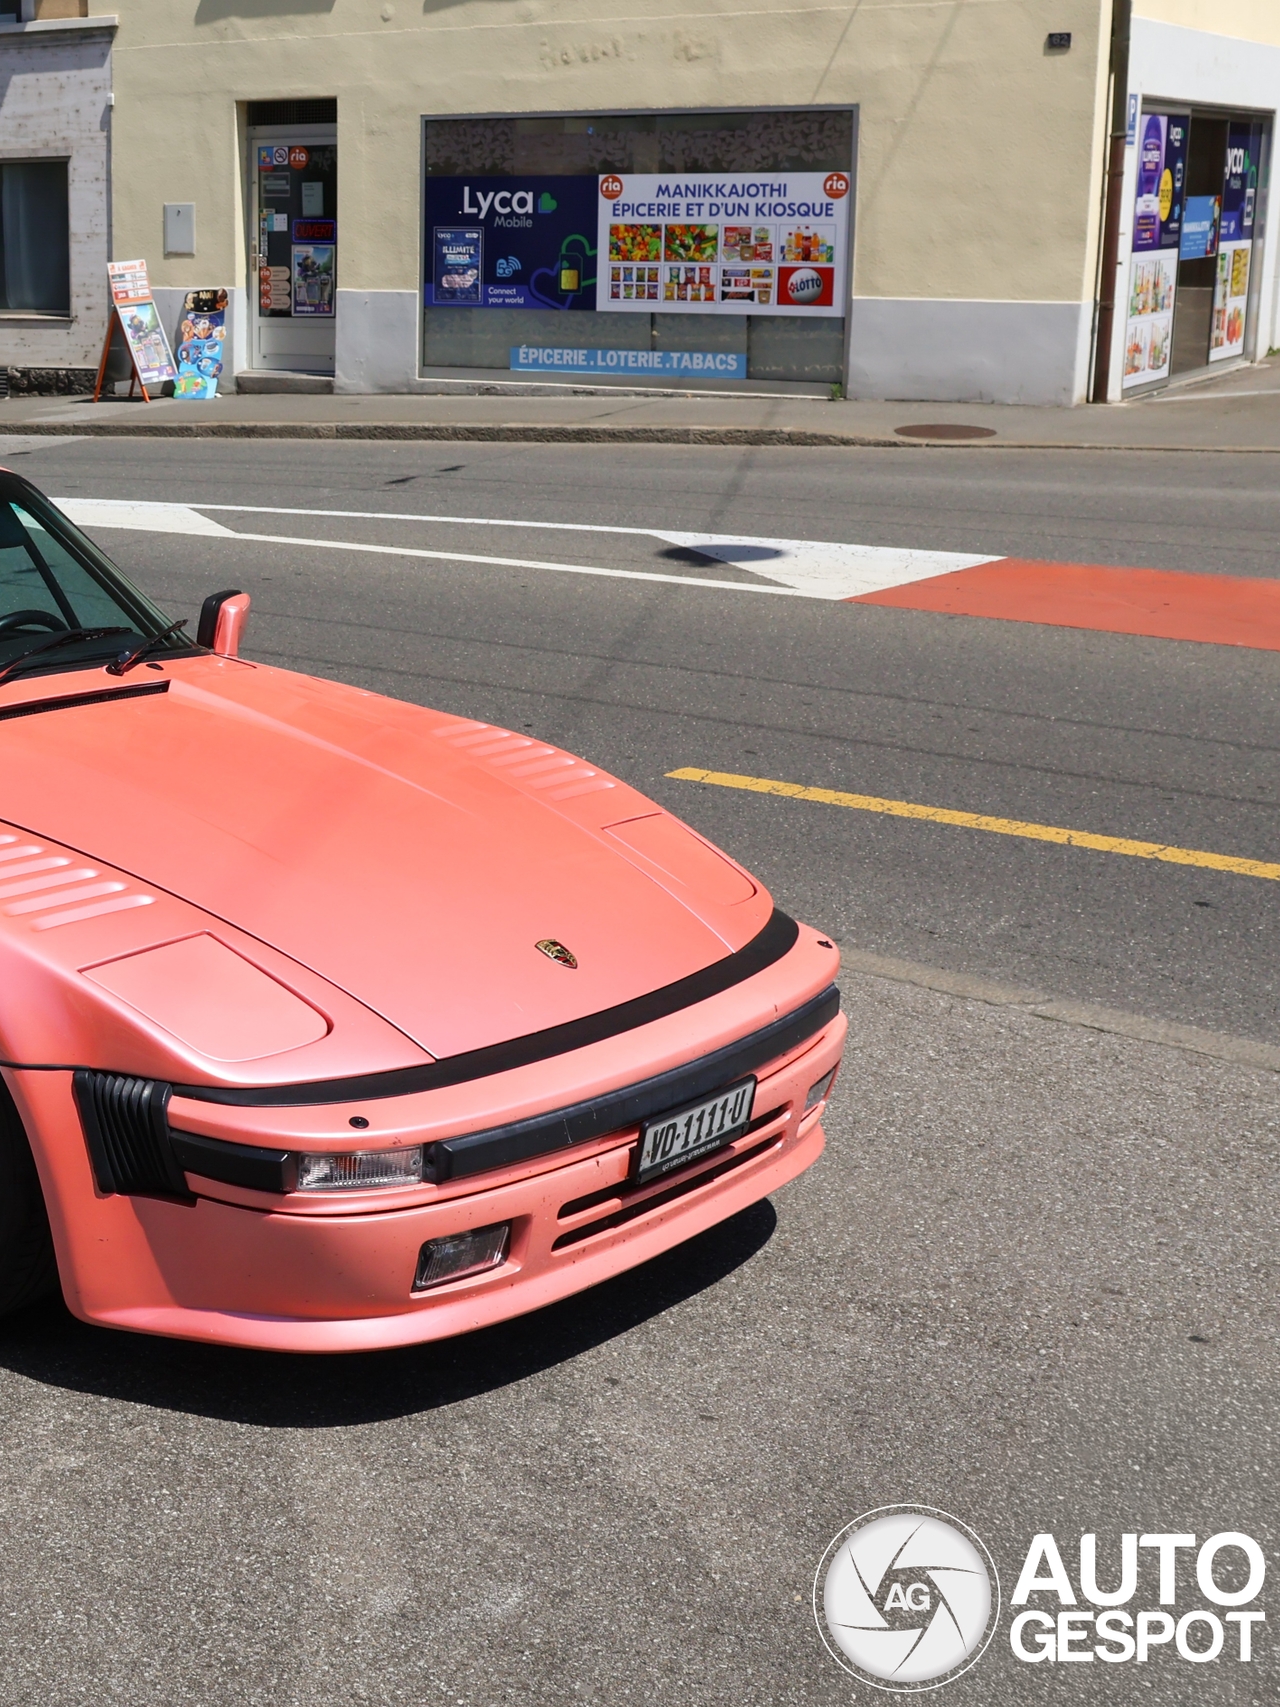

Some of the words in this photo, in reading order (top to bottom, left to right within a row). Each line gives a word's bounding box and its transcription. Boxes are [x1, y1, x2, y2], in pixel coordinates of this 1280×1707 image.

[291, 149, 306, 161] ria
[1224, 148, 1244, 180] yca
[602, 180, 620, 191] ria
[825, 178, 846, 190] ria
[655, 183, 787, 198] MANIKKAJOTHI
[463, 186, 533, 219] Lyca
[612, 200, 680, 217] ÉPICERIE
[686, 203, 704, 217] ET
[709, 202, 749, 217] D'UN
[755, 202, 834, 217] KIOSQUE
[494, 216, 533, 228] Mobile
[295, 224, 333, 237] OUVERT
[488, 286, 516, 295] Connect
[796, 277, 822, 292] LOTTO
[505, 296, 524, 304] world
